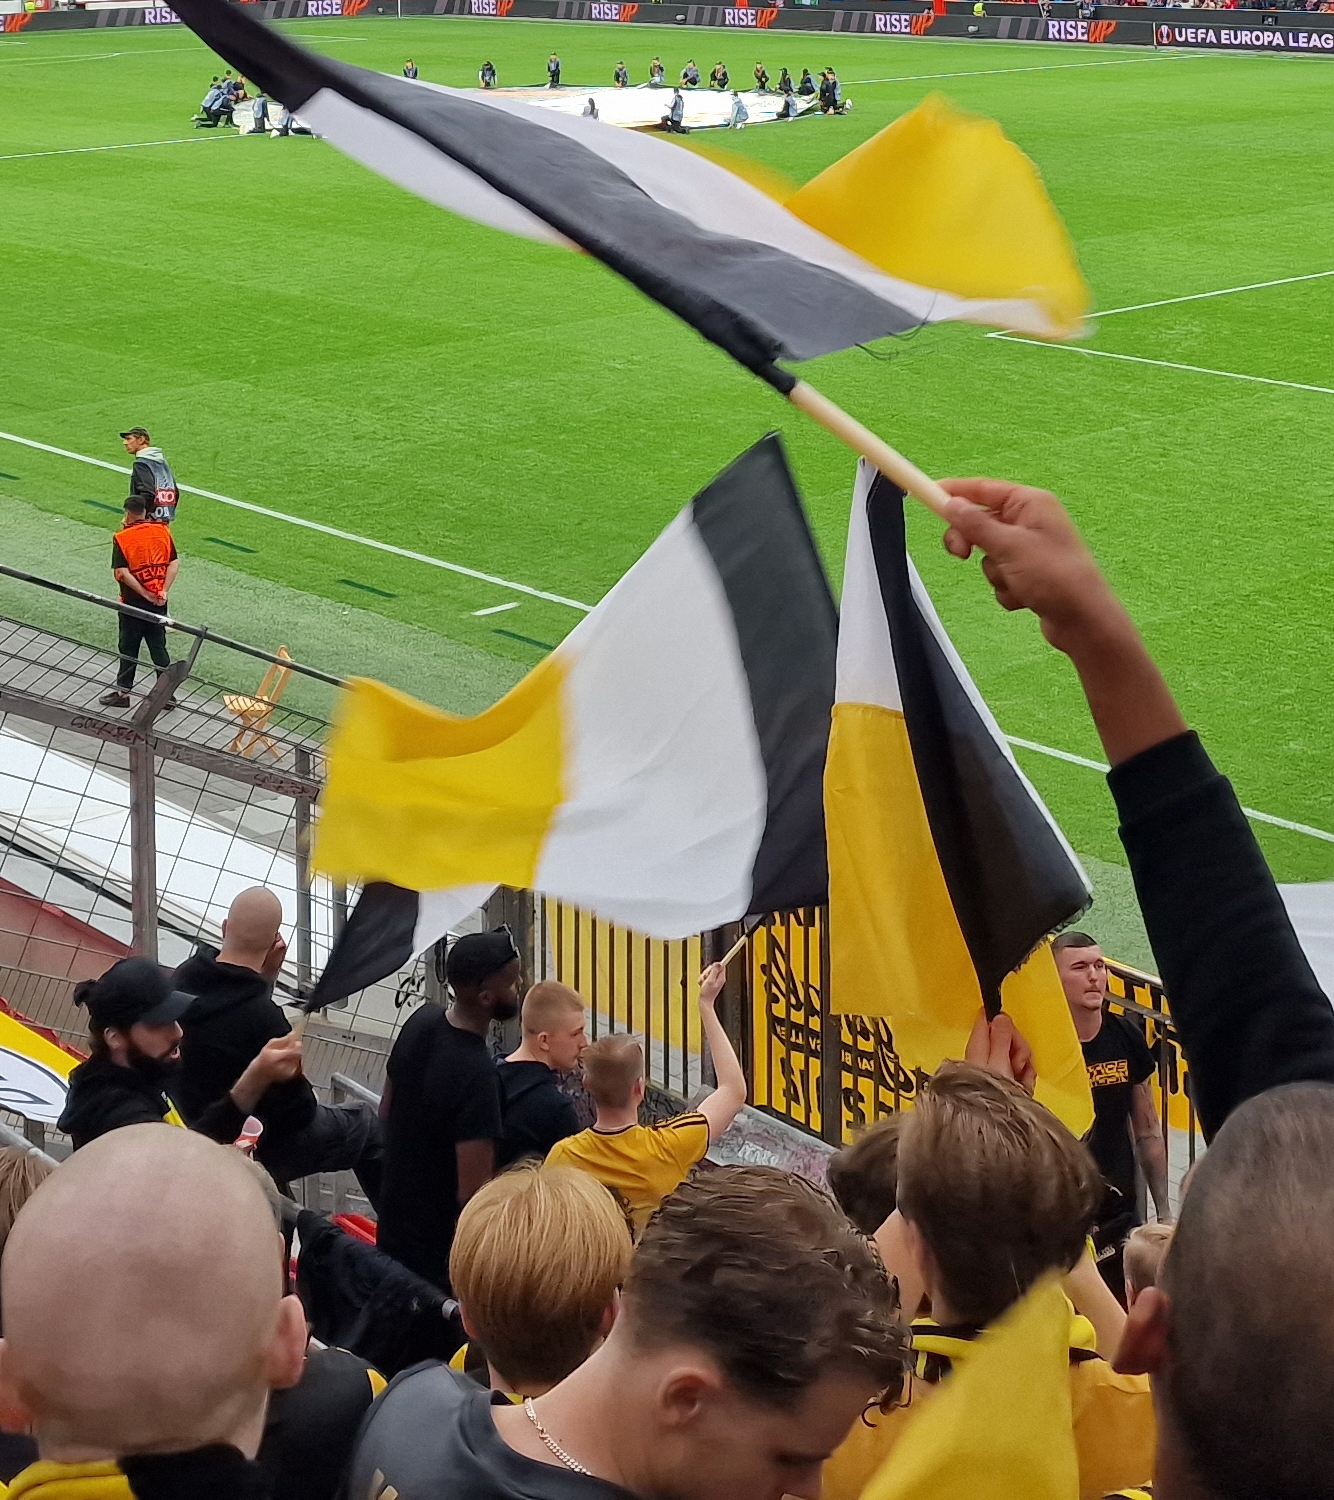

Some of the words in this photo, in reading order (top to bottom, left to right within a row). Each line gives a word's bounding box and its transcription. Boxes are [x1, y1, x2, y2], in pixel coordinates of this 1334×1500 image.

[307, 0, 342, 16] RISE
[342, 0, 369, 16] UP
[471, 0, 496, 15] RISE
[591, 3, 619, 21] RISE
[619, 3, 638, 22] UP
[4, 13, 33, 32] UP
[724, 8, 756, 26] RISE
[756, 8, 778, 28] UP
[875, 13, 910, 33] RISE
[910, 13, 935, 35] UP
[1048, 20, 1088, 41] RISE
[1088, 20, 1117, 43] UP
[1175, 27, 1216, 44] UEFA
[1220, 29, 1285, 47] EUROPA
